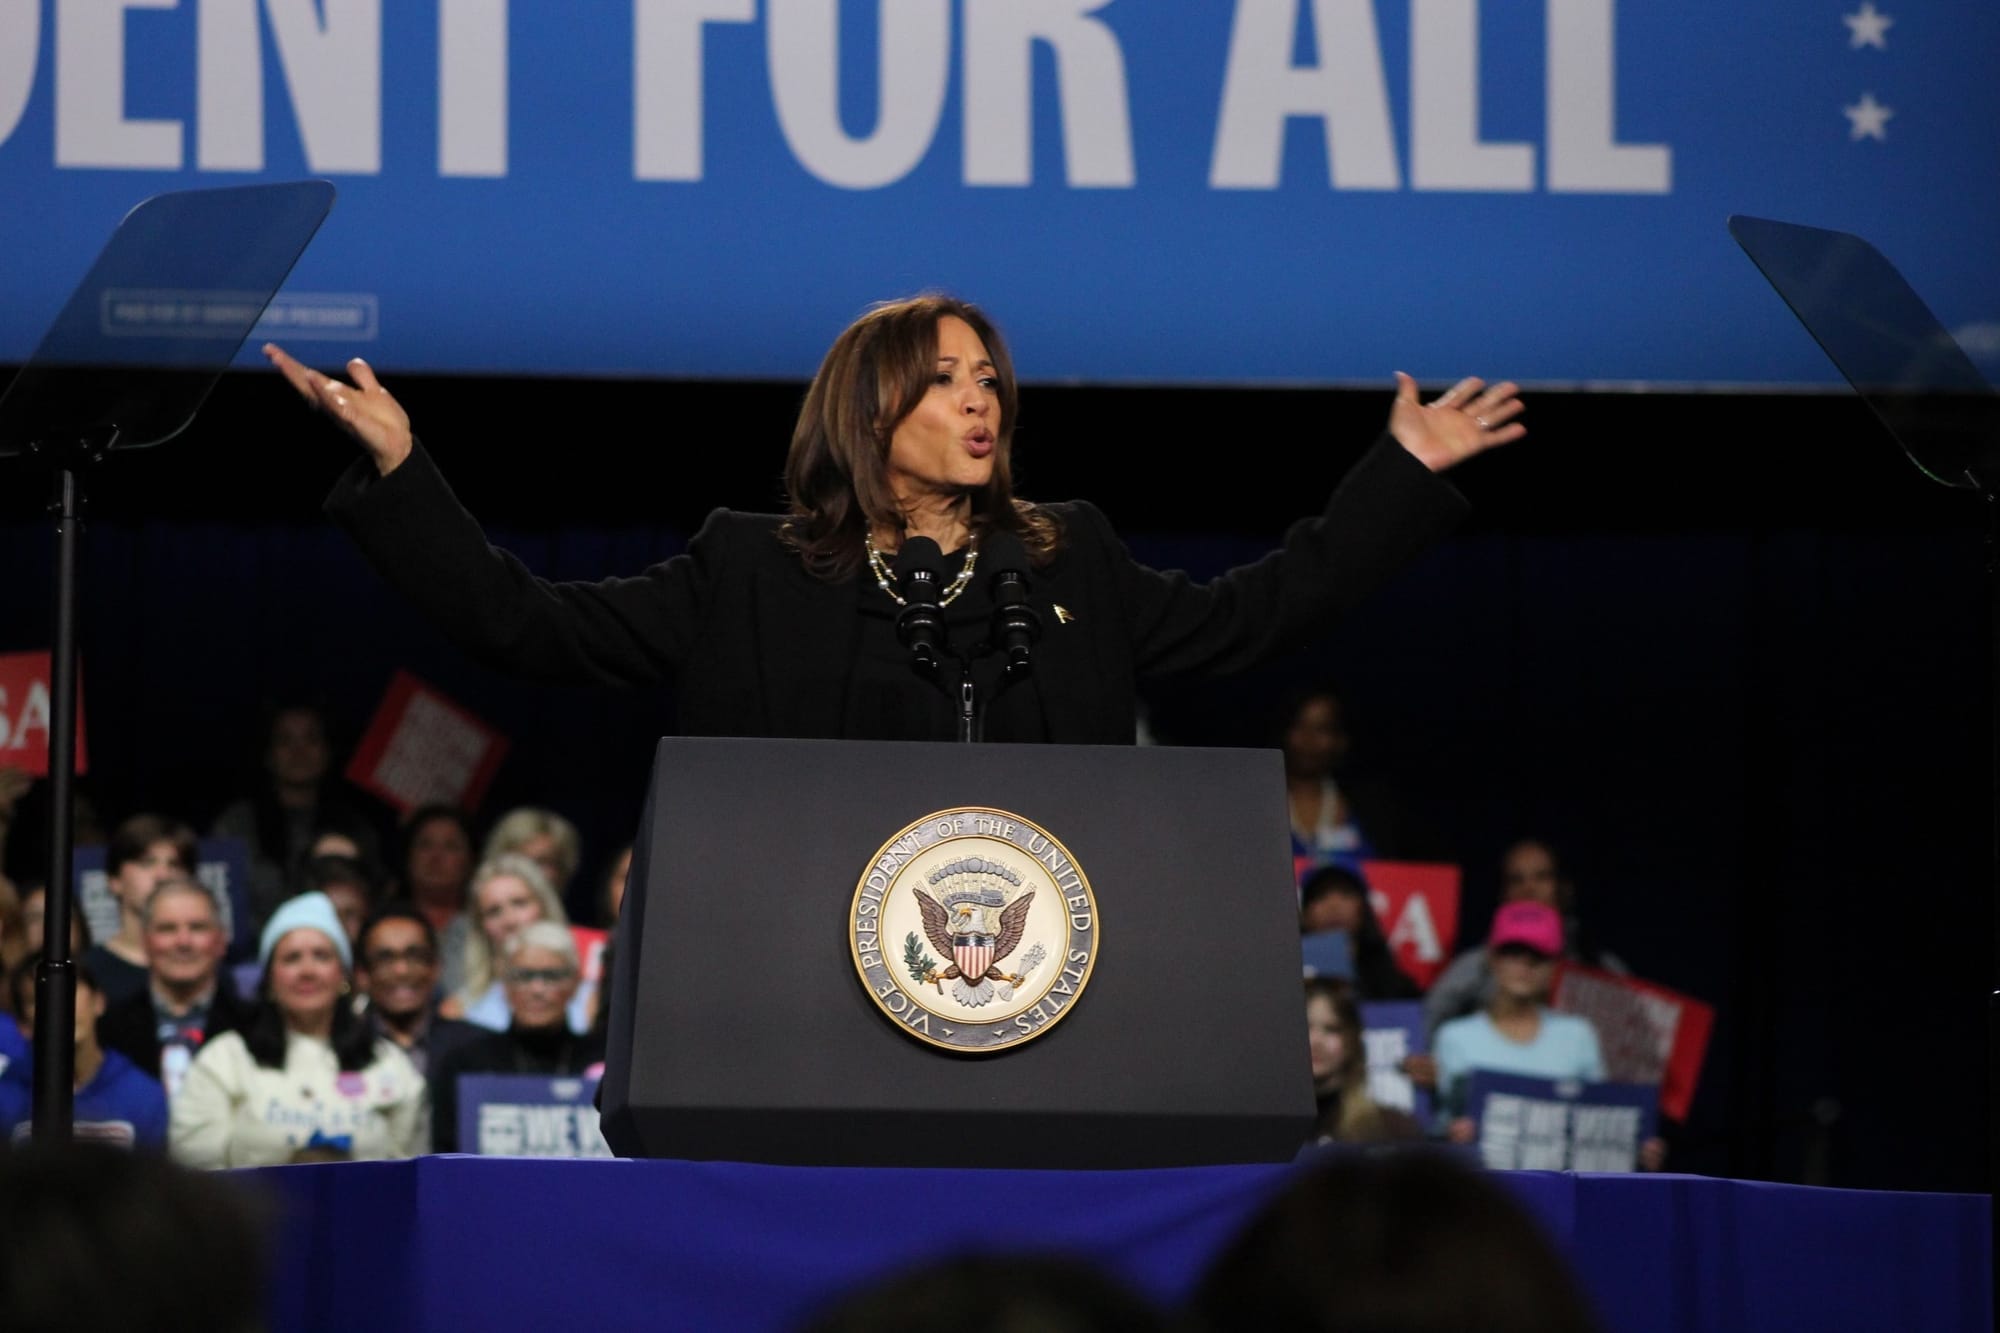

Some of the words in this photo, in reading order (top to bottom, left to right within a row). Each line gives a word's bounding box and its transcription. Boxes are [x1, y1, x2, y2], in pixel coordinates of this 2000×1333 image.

[1209, 0, 1672, 193] ALL
[936, 819, 964, 838] OF
[975, 817, 1016, 840] THE
[856, 829, 924, 970] PRESIDENT
[1027, 833, 1093, 932] UNITED
[875, 979, 930, 1036] VICE
[1014, 948, 1088, 1036] STATES
